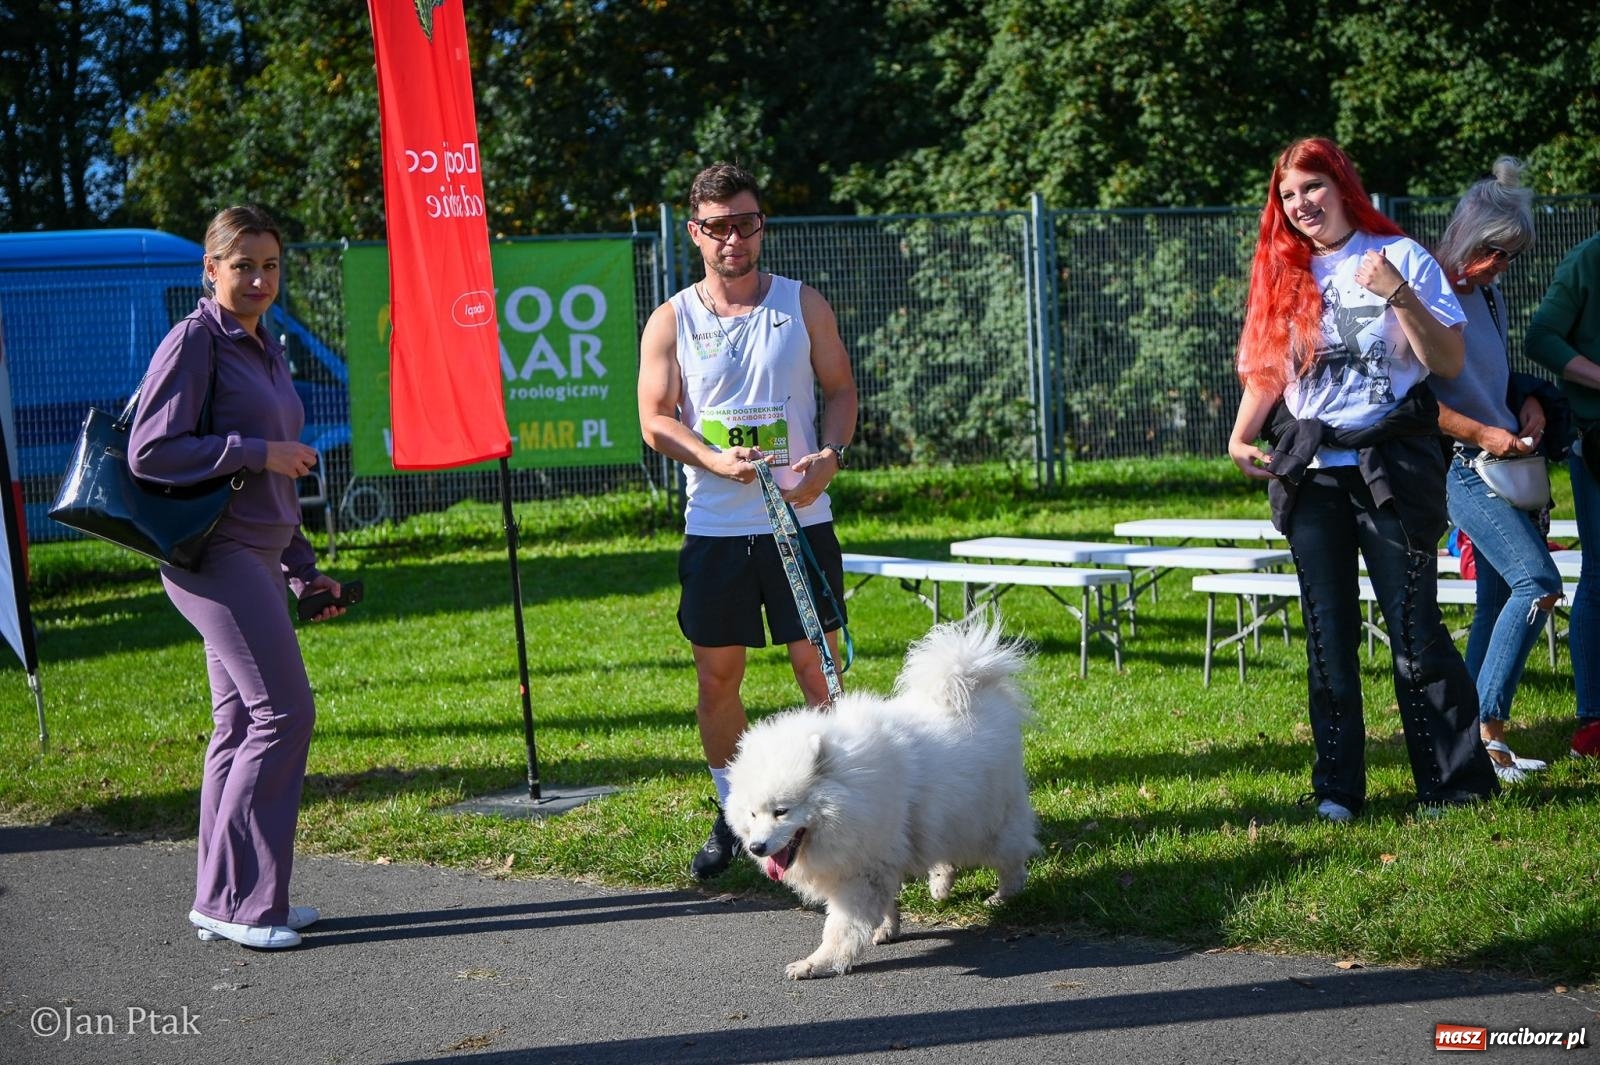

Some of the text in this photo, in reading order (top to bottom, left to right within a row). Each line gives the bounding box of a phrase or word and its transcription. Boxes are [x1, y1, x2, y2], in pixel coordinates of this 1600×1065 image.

[495, 285, 607, 333] OO
[509, 383, 609, 401] zoologiczny
[733, 405, 784, 415] DOGTREKKING
[728, 426, 759, 447] 81
